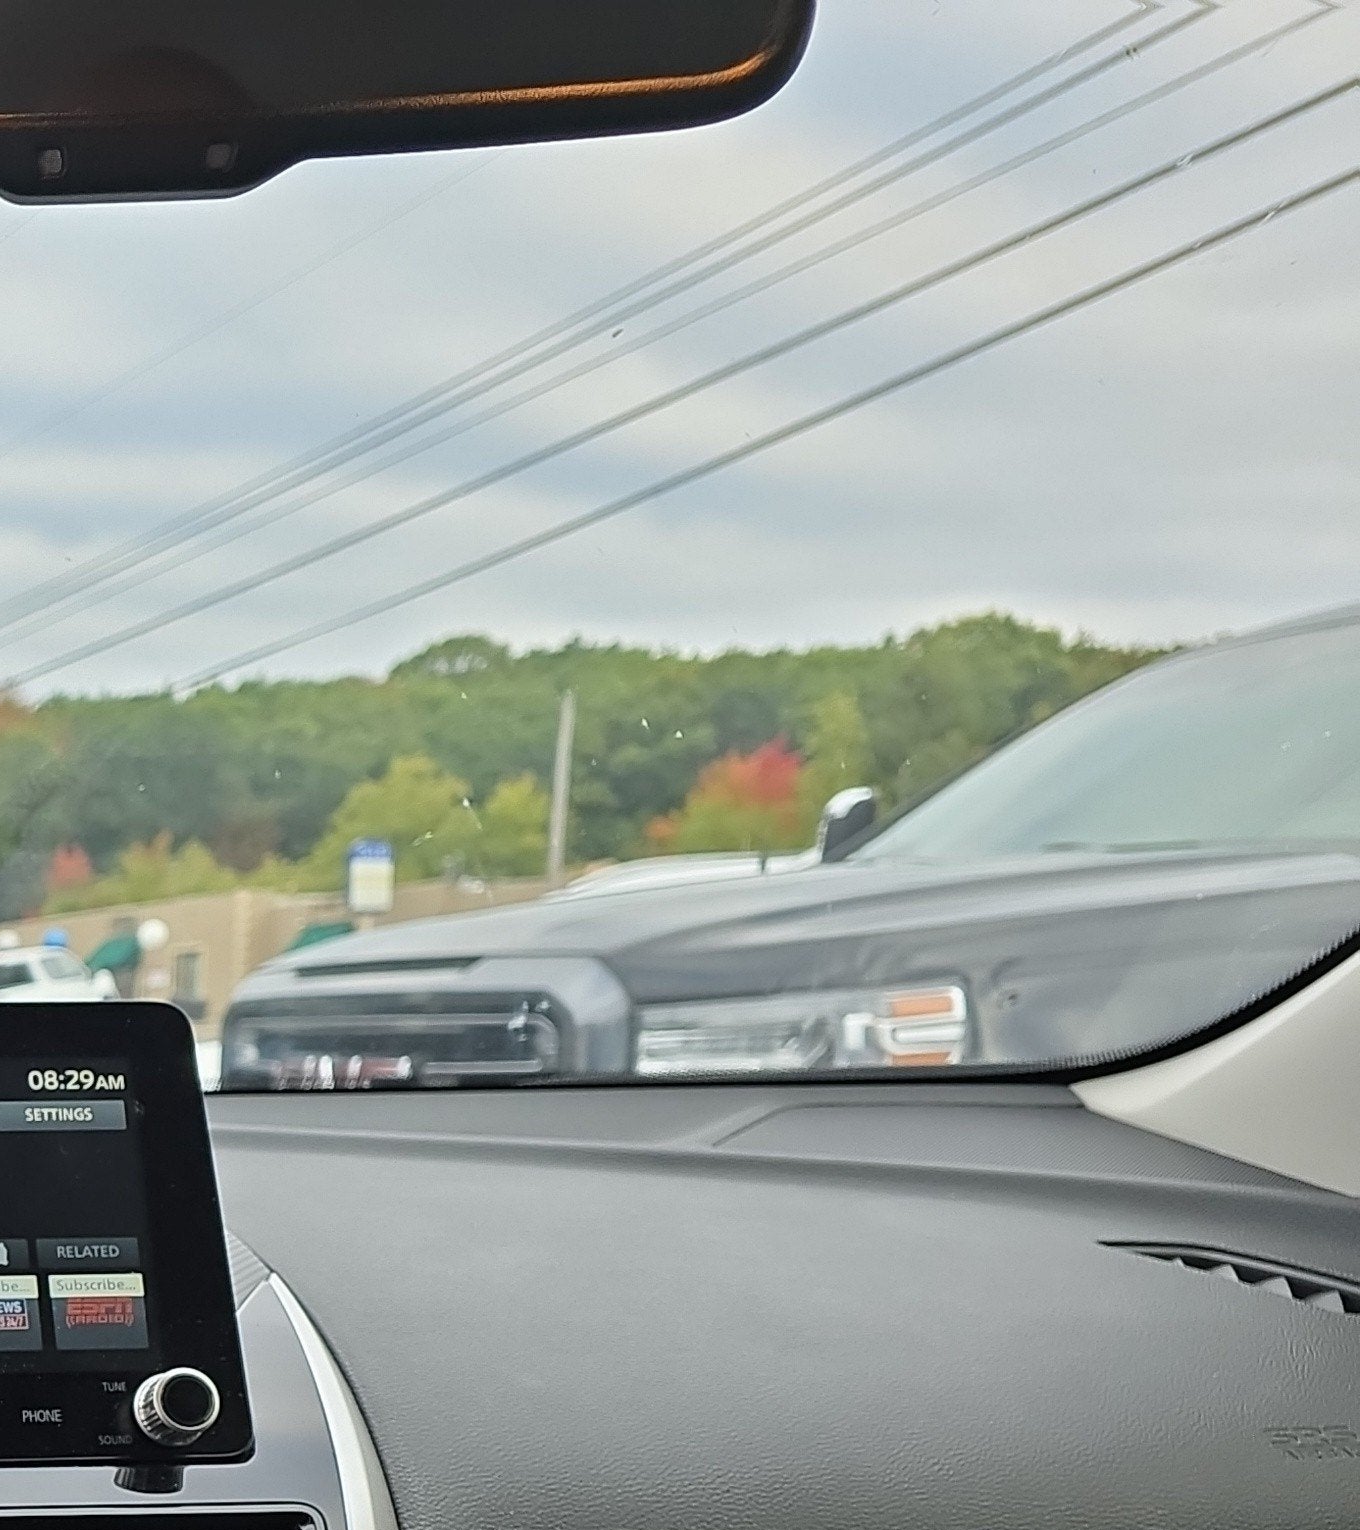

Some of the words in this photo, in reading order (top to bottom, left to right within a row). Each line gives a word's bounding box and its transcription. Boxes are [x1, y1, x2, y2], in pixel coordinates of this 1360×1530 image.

[24, 1107, 94, 1122] SETTINGS
[56, 1245, 120, 1259] RELATED
[56, 1279, 136, 1292] Subscribe...
[102, 1381, 127, 1393] TUNE
[21, 1409, 62, 1423] PHONE
[98, 1434, 133, 1446] SOUND
